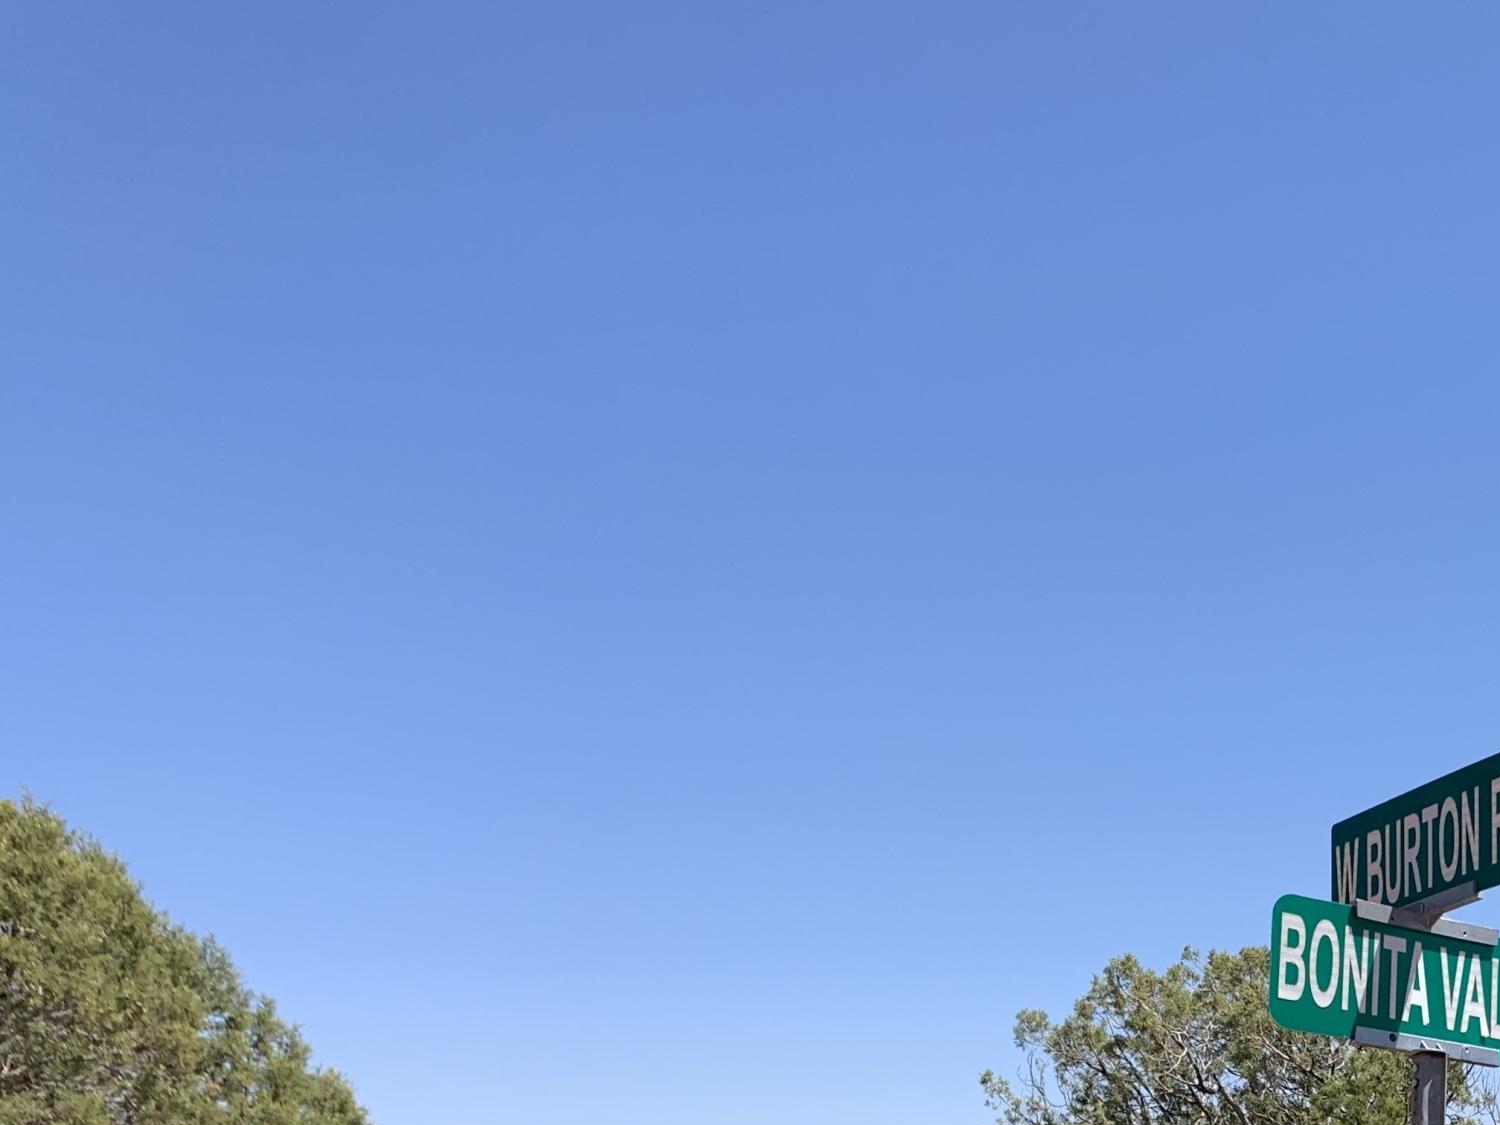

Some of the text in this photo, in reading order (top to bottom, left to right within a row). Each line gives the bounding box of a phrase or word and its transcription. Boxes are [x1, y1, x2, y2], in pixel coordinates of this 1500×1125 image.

[1336, 837, 1360, 905] W
[1367, 786, 1480, 906] BURTON
[1278, 911, 1430, 1025] BONITA
